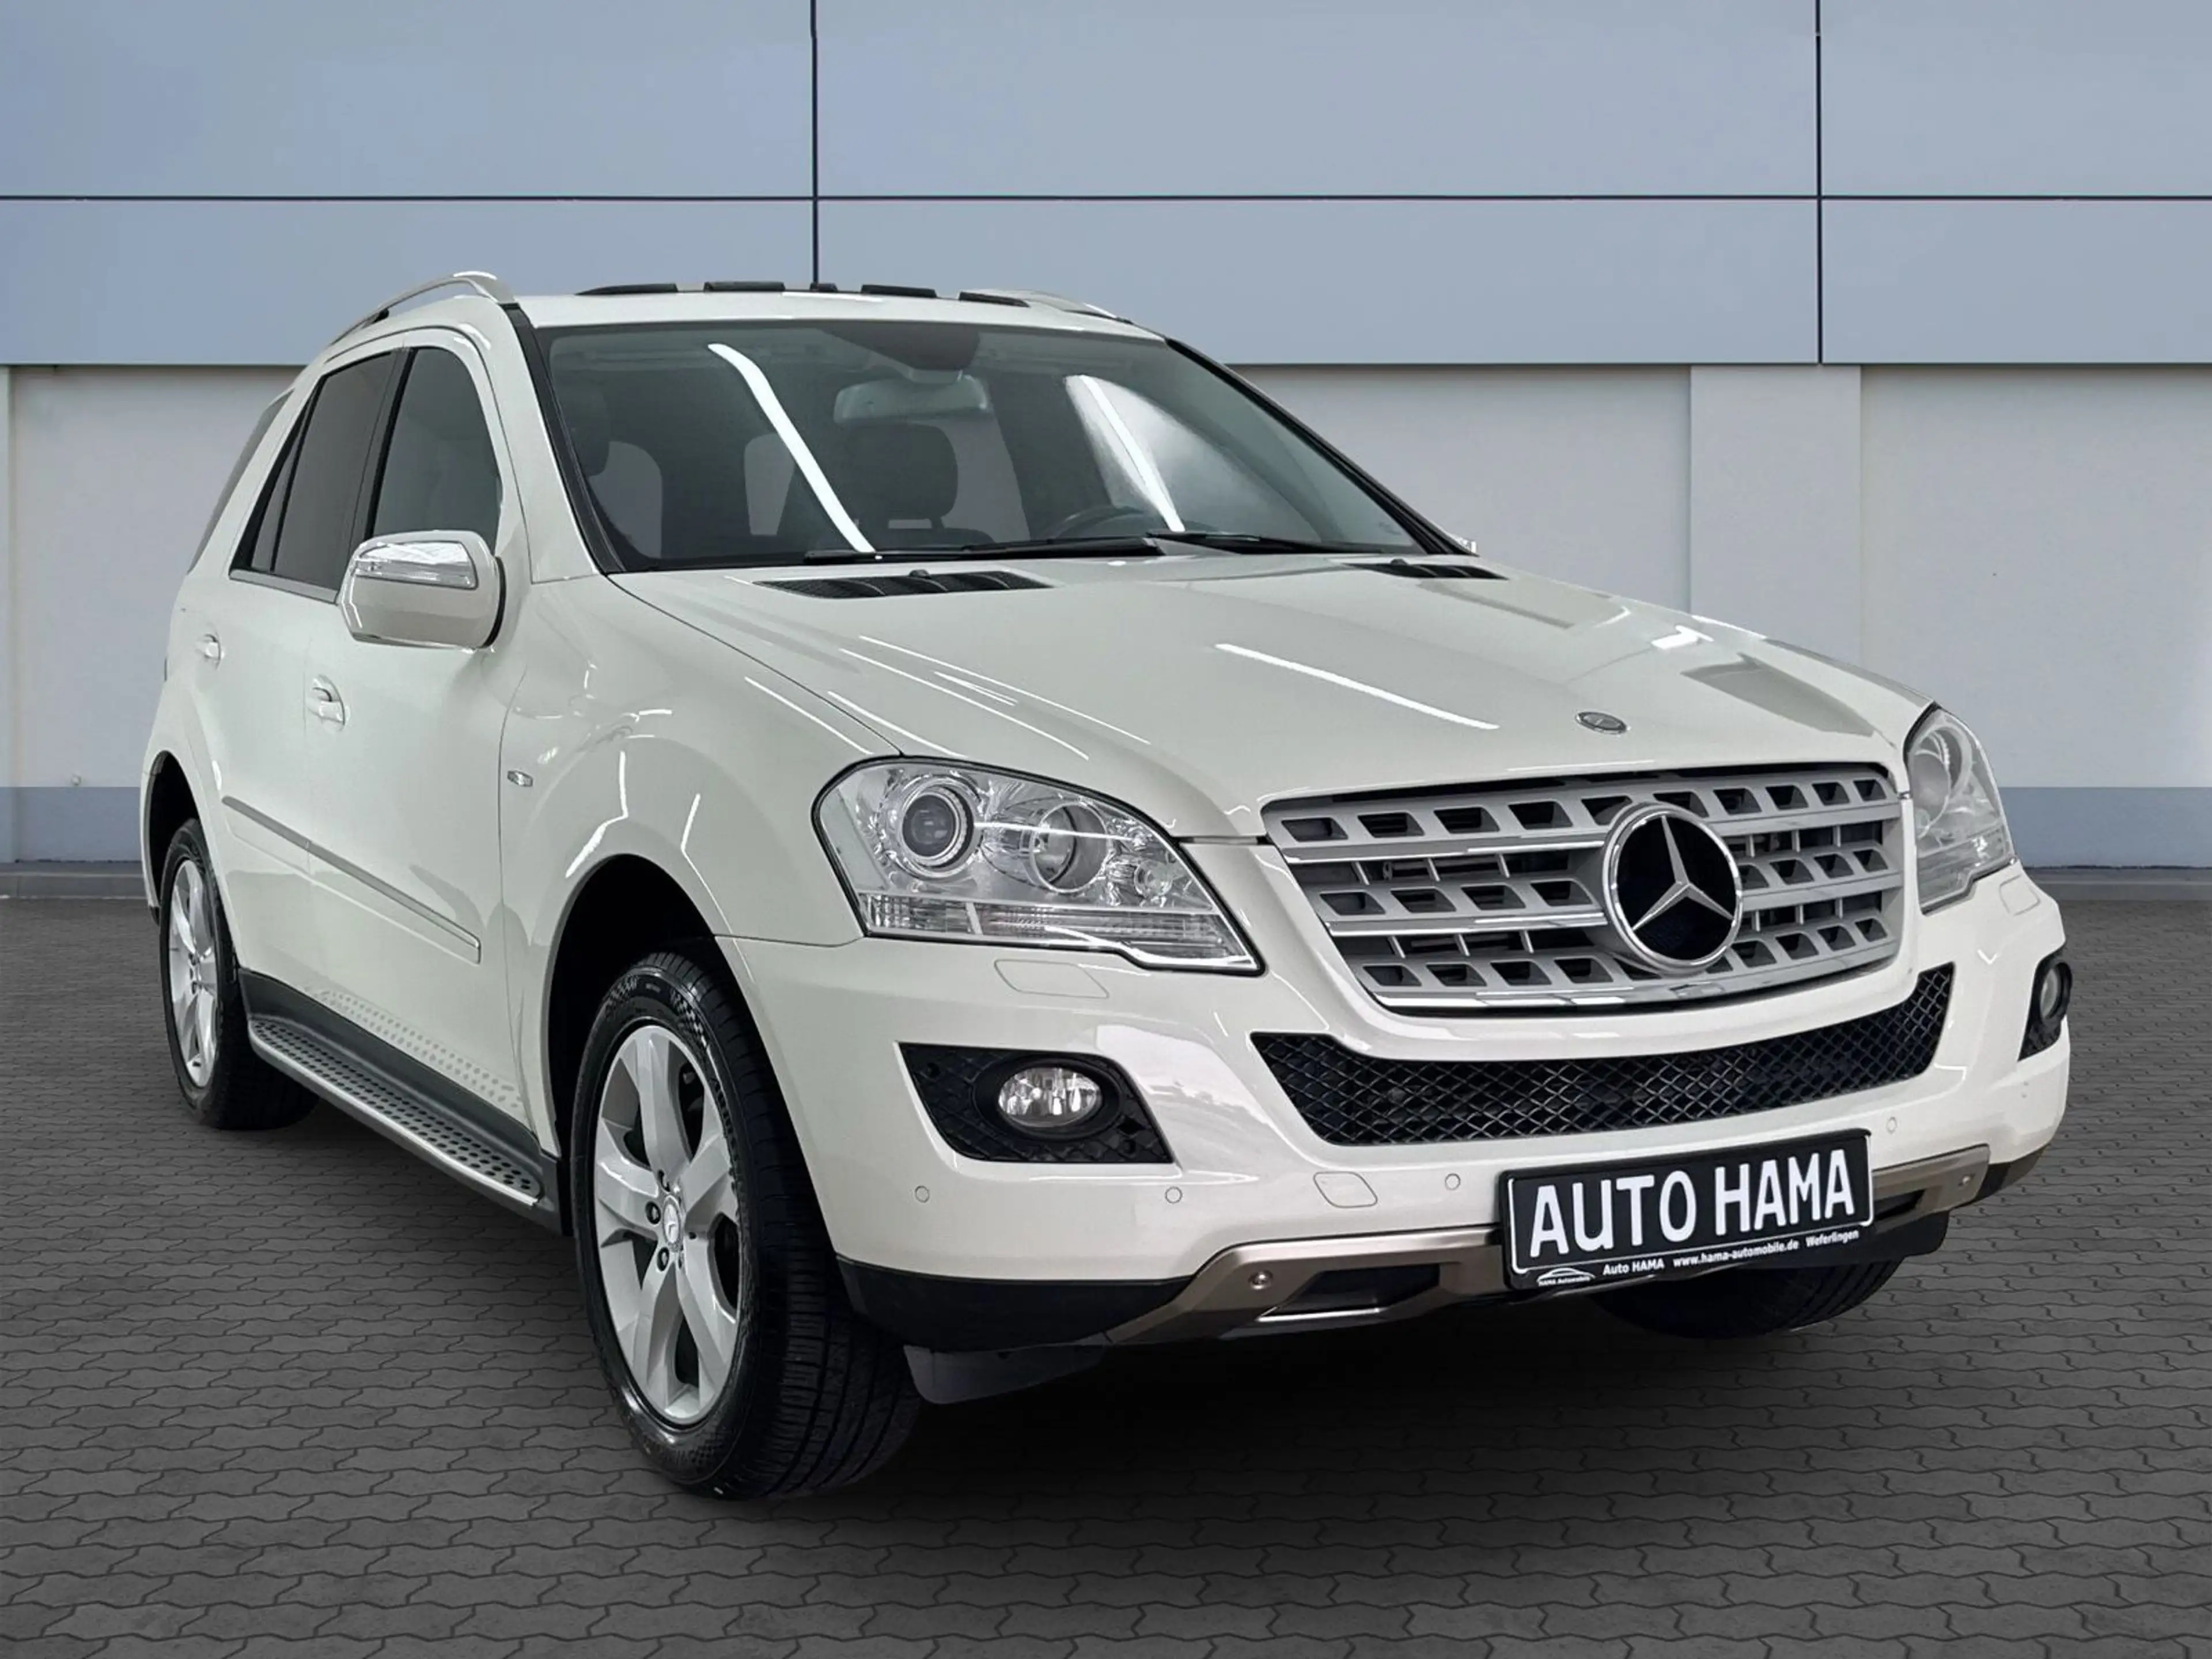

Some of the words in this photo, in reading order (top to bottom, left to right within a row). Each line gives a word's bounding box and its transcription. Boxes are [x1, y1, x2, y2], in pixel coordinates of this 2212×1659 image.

[1529, 1171, 1696, 1257] AUTO
[1714, 1149, 1855, 1236] HAMA
[1603, 1263, 1630, 1275] Auto
[1632, 1257, 1665, 1272] HAMA
[1673, 1239, 1800, 1267] www.hama-automobile.de
